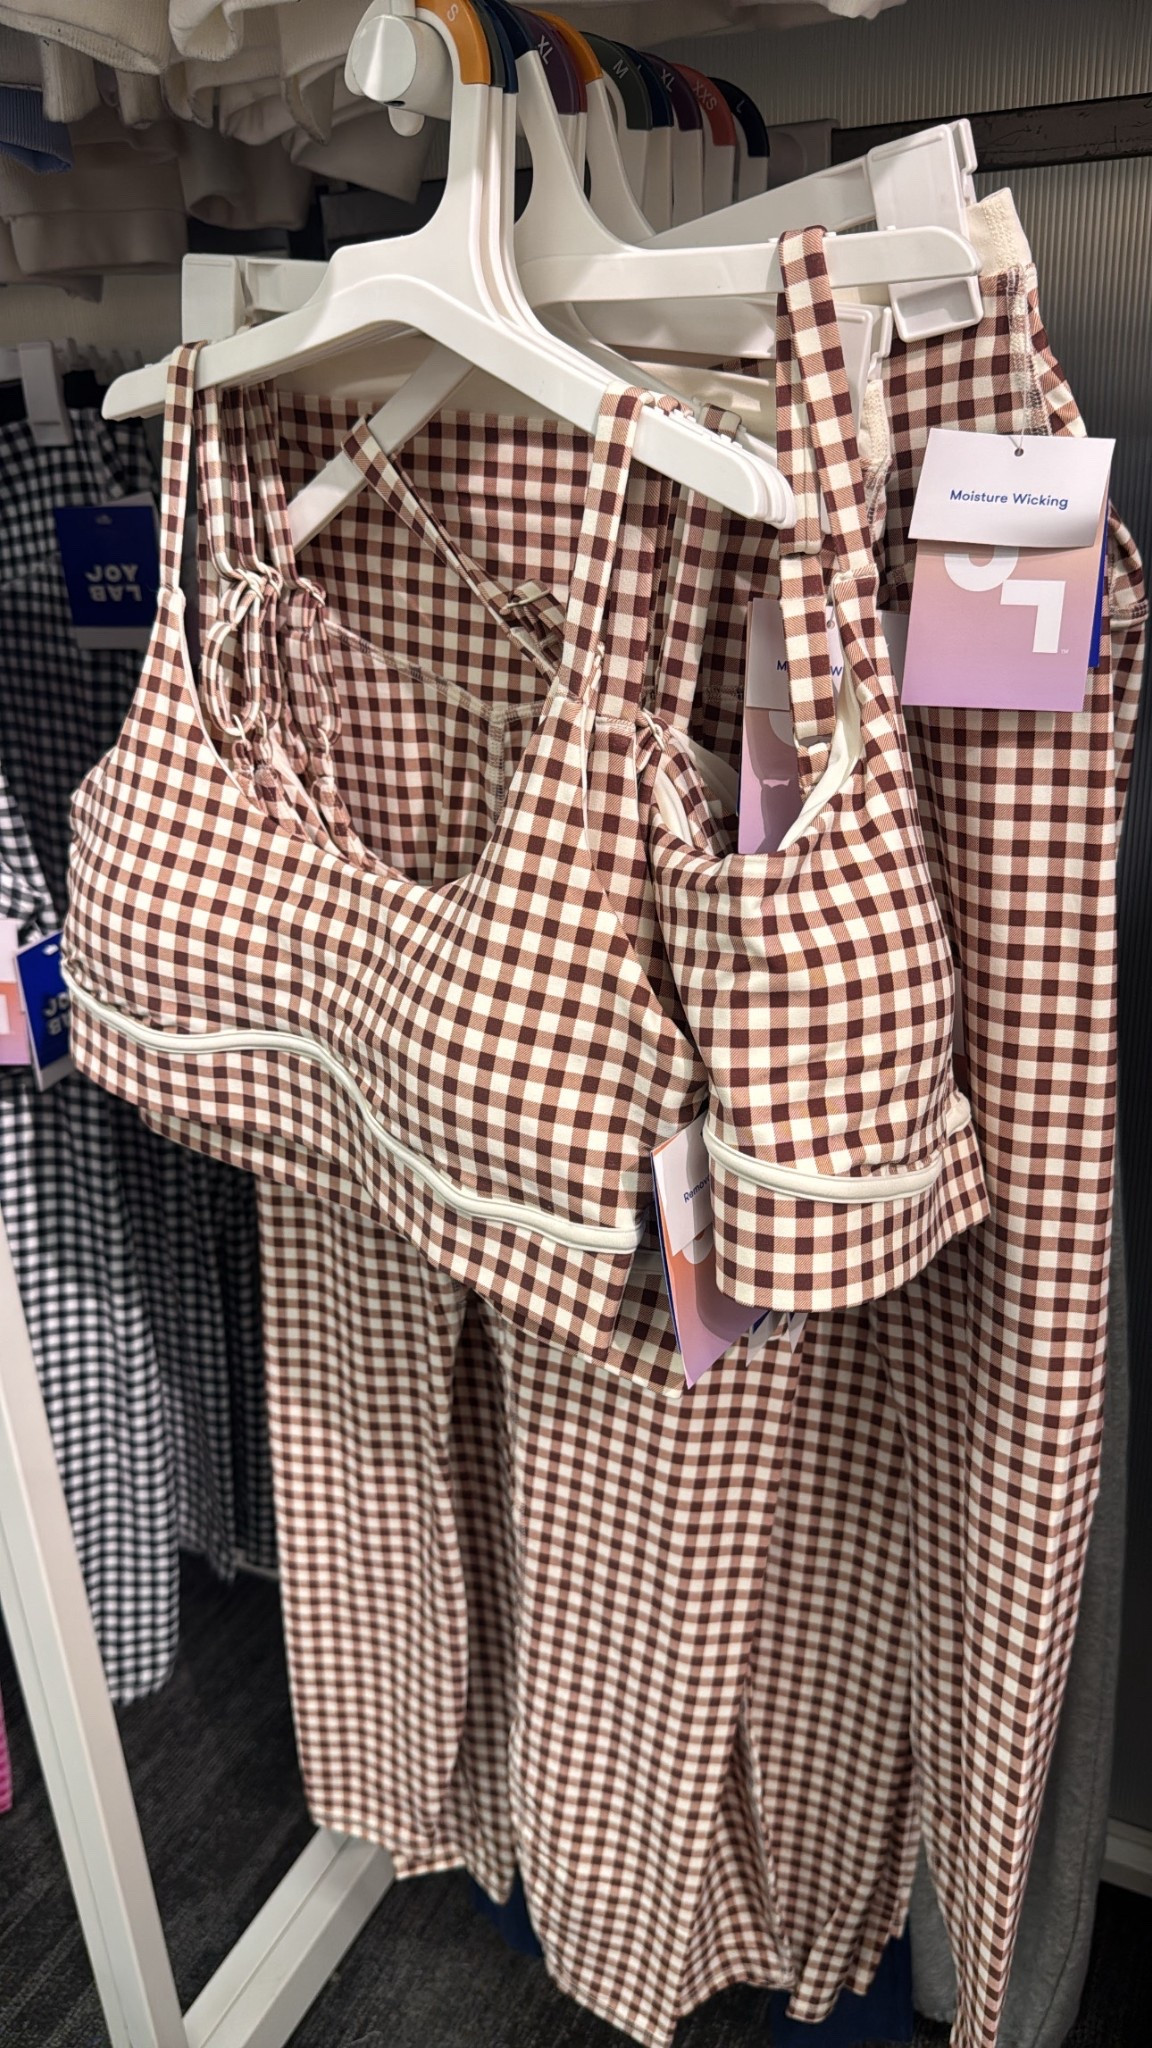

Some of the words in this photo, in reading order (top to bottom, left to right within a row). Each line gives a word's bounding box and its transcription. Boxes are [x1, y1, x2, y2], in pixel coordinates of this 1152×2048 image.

[447, 4, 459, 21] S
[537, 34, 553, 65] XL
[612, 59, 628, 79] M
[660, 68, 675, 94] XL
[692, 80, 718, 111] XXS
[736, 99, 749, 114] L
[950, 489, 1008, 504] Moisture
[1012, 492, 1068, 511] Wicking
[84, 563, 139, 583] JOY
[88, 584, 143, 602] LAB
[44, 992, 70, 1017] JO
[683, 1174, 710, 1203] Remov
